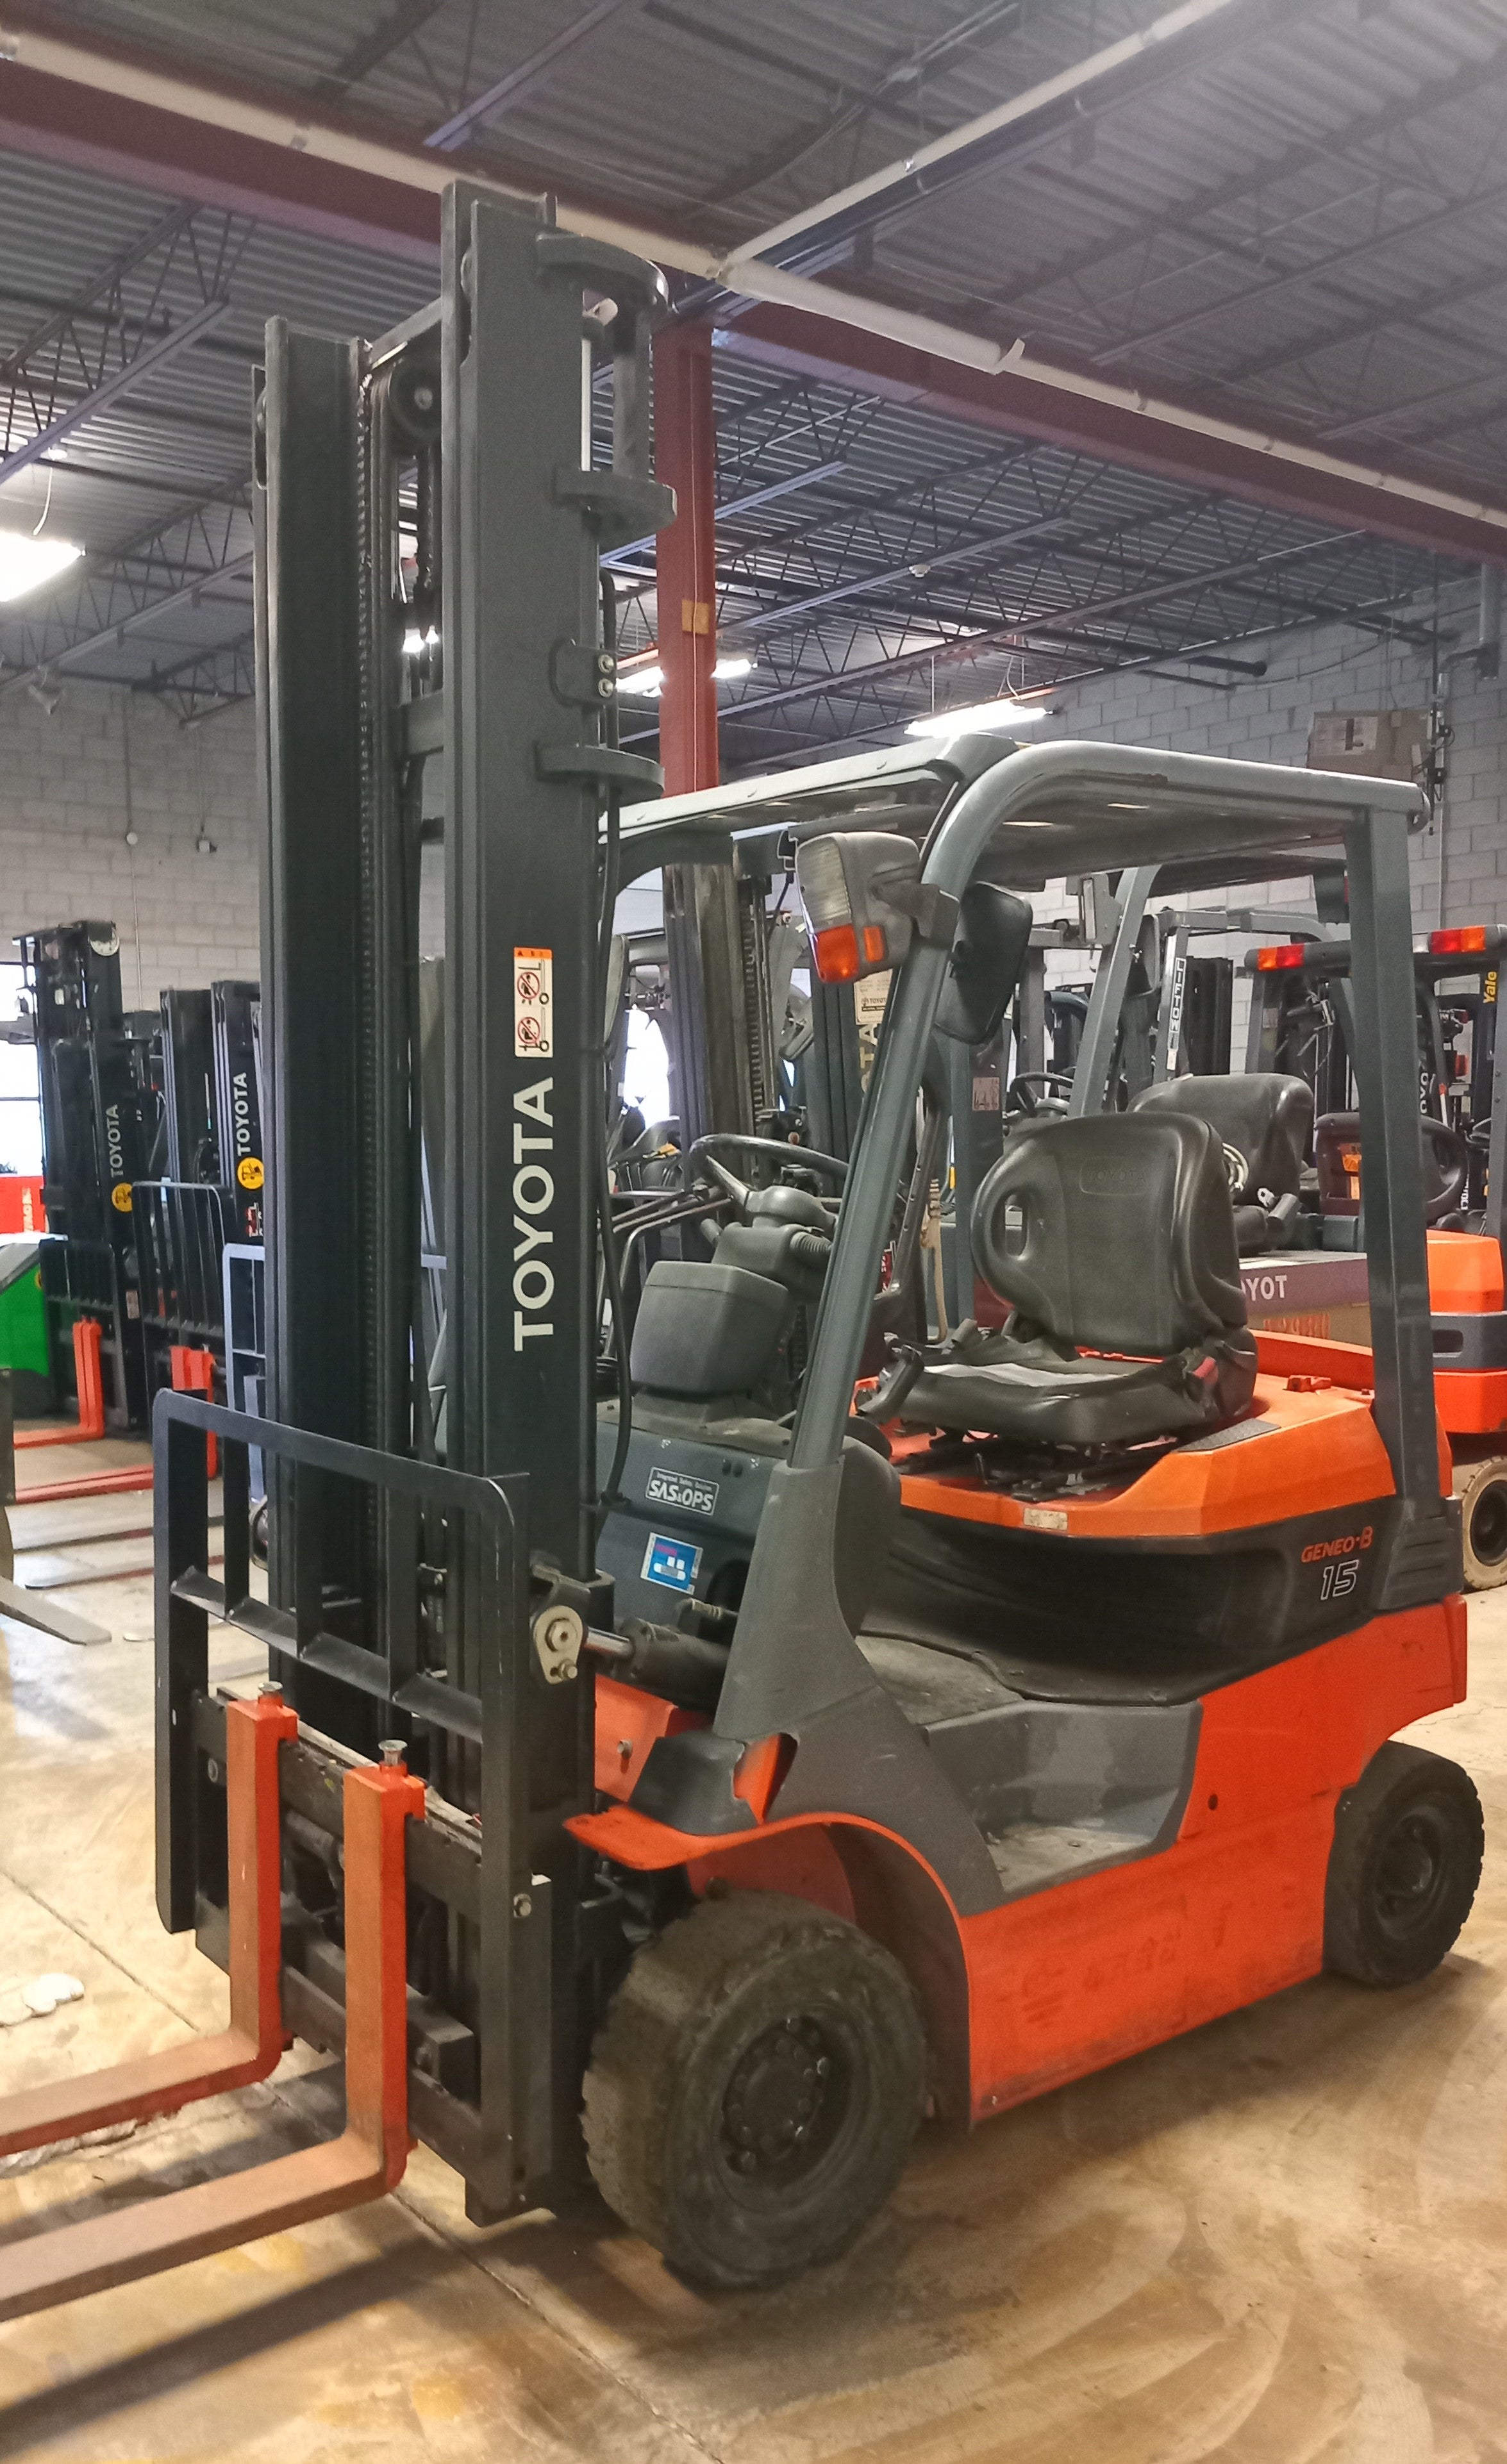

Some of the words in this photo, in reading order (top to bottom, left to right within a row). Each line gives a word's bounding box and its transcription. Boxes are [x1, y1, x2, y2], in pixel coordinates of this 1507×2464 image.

[1483, 970, 1497, 1004] Yale
[106, 1104, 124, 1178] TOYOTA
[233, 1072, 251, 1156] TOYOTA
[513, 1076, 554, 1352] TOYOTA
[1320, 1559, 1360, 1601] 15
